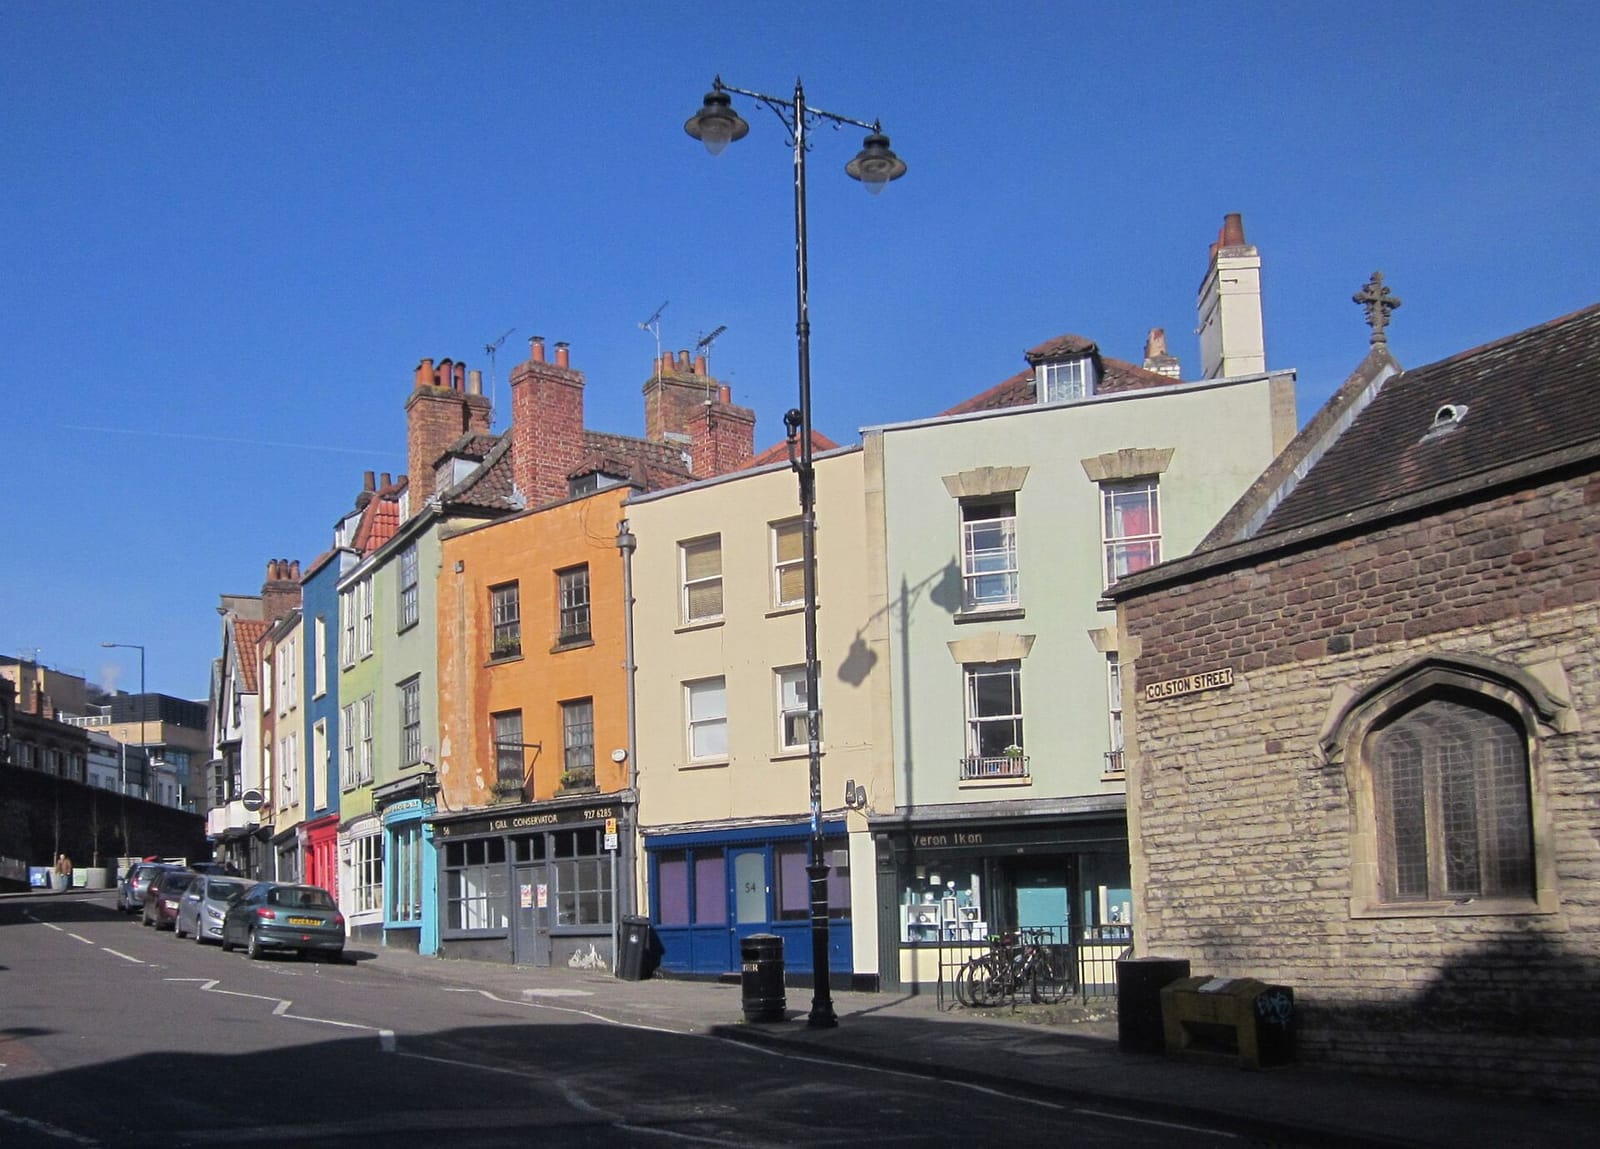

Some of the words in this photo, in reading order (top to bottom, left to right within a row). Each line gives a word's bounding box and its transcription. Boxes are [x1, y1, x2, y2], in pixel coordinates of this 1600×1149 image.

[1148, 679, 1190, 697] COLSTON
[1195, 670, 1230, 688] STREET
[584, 810, 595, 820] 927
[596, 808, 612, 818] 6285
[495, 819, 508, 830] GILL
[513, 815, 559, 827] CONSERVATOR
[744, 881, 756, 894] 54
